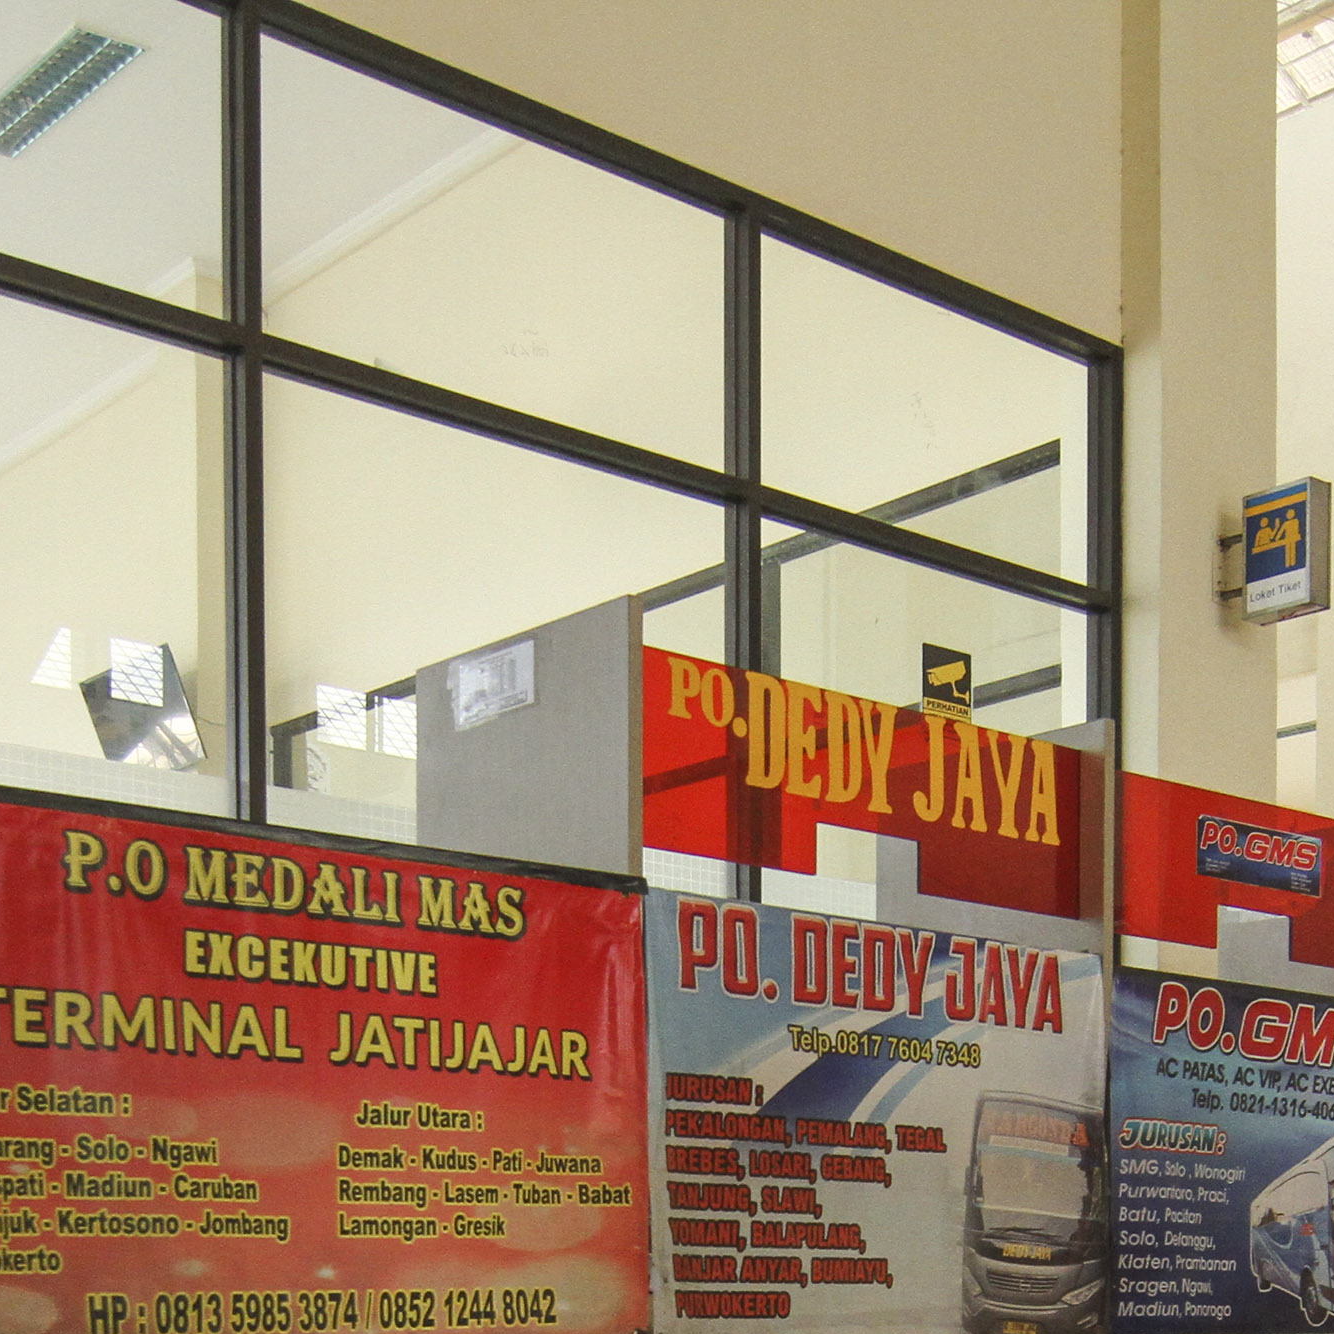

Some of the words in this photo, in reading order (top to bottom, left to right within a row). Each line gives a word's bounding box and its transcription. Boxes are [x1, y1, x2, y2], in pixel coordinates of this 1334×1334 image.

[1278, 581, 1301, 594] Tiket
[925, 699, 970, 717] PERHATIAN
[667, 656, 899, 815] PO.DEDY
[913, 714, 1061, 847] JAYA
[1200, 821, 1318, 871] PO.GMS
[64, 829, 165, 897] P.O
[184, 845, 402, 925] MEDALI
[417, 877, 527, 938] MAS
[184, 930, 438, 996] EXCEKUTIVE
[677, 897, 779, 1004] PO.
[791, 913, 934, 1019] DEDY
[944, 936, 1063, 1034] JAYA
[330, 1011, 592, 1079] JATIJAJAR
[888, 1036, 933, 1064] 7604
[937, 1040, 981, 1067] 7348
[1157, 1058, 1178, 1077] AC
[1182, 1061, 1228, 1085] PATAS,
[1233, 1066, 1254, 1085] AC
[1286, 1072, 1309, 1091] AC
[355, 1101, 412, 1129] Jalur
[1192, 1088, 1224, 1113] Telp.
[76, 1136, 130, 1163] Solo
[150, 1138, 218, 1169] Ngawi
[336, 1145, 405, 1171] Demak
[421, 1147, 479, 1173] Kudus
[490, 1148, 524, 1174] Pati
[534, 1151, 602, 1176] Juwana
[65, 1174, 153, 1201] Madiun
[173, 1176, 259, 1202] Caruban
[336, 1180, 429, 1210] Rembang
[443, 1182, 500, 1205] Lasem
[511, 1182, 562, 1206] Tuban
[576, 1183, 632, 1206] Babat
[57, 1209, 180, 1237] Kertosono
[199, 1212, 290, 1242] Jombang
[336, 1212, 439, 1242] Lamongan
[453, 1212, 506, 1238] Gresik
[155, 1294, 223, 1334] 0813
[230, 1291, 291, 1333] 5985
[298, 1291, 360, 1332] 3874
[377, 1288, 436, 1330] 0852
[443, 1288, 497, 1329] 1244
[501, 1287, 558, 1327] 8042
[675, 1290, 791, 1319] PURWOKERTO
